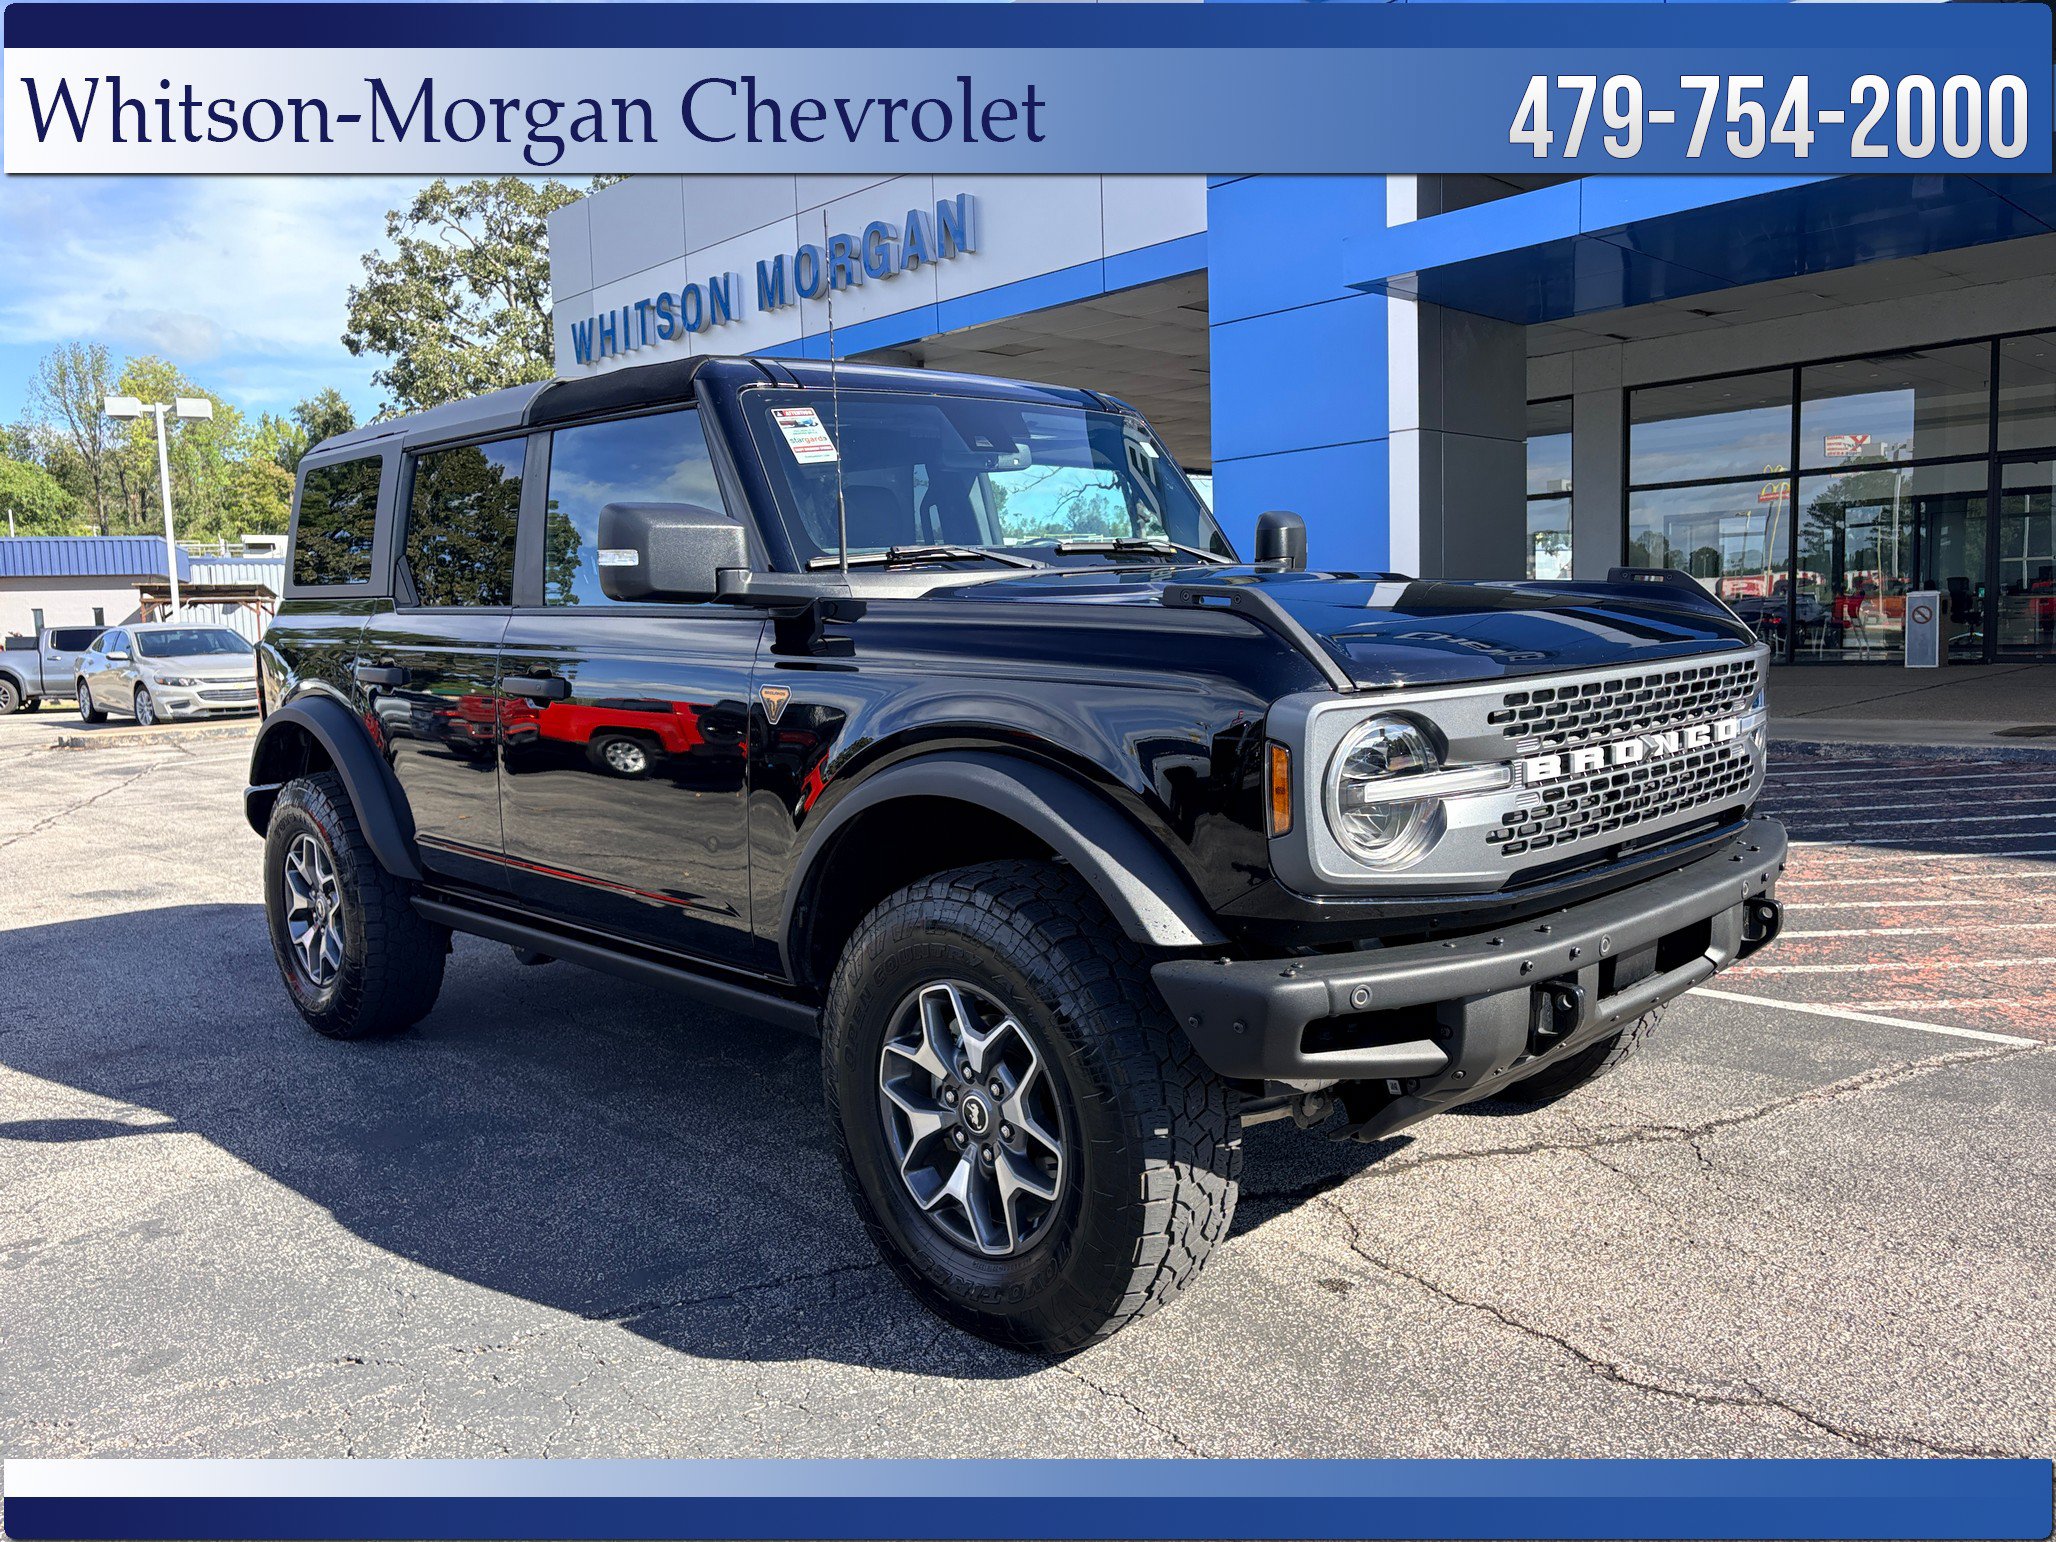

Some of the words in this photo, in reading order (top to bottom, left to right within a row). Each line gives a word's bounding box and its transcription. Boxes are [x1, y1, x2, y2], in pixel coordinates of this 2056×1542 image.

[571, 272, 740, 365] WHITSON
[757, 193, 976, 312] MORGAN
[1522, 716, 1740, 784] BRONCO
[844, 981, 874, 1072] OPEN
[872, 942, 984, 988] COUNTRY
[916, 1250, 1002, 1304] TIRES
[1008, 1241, 1072, 1305] TOYO
